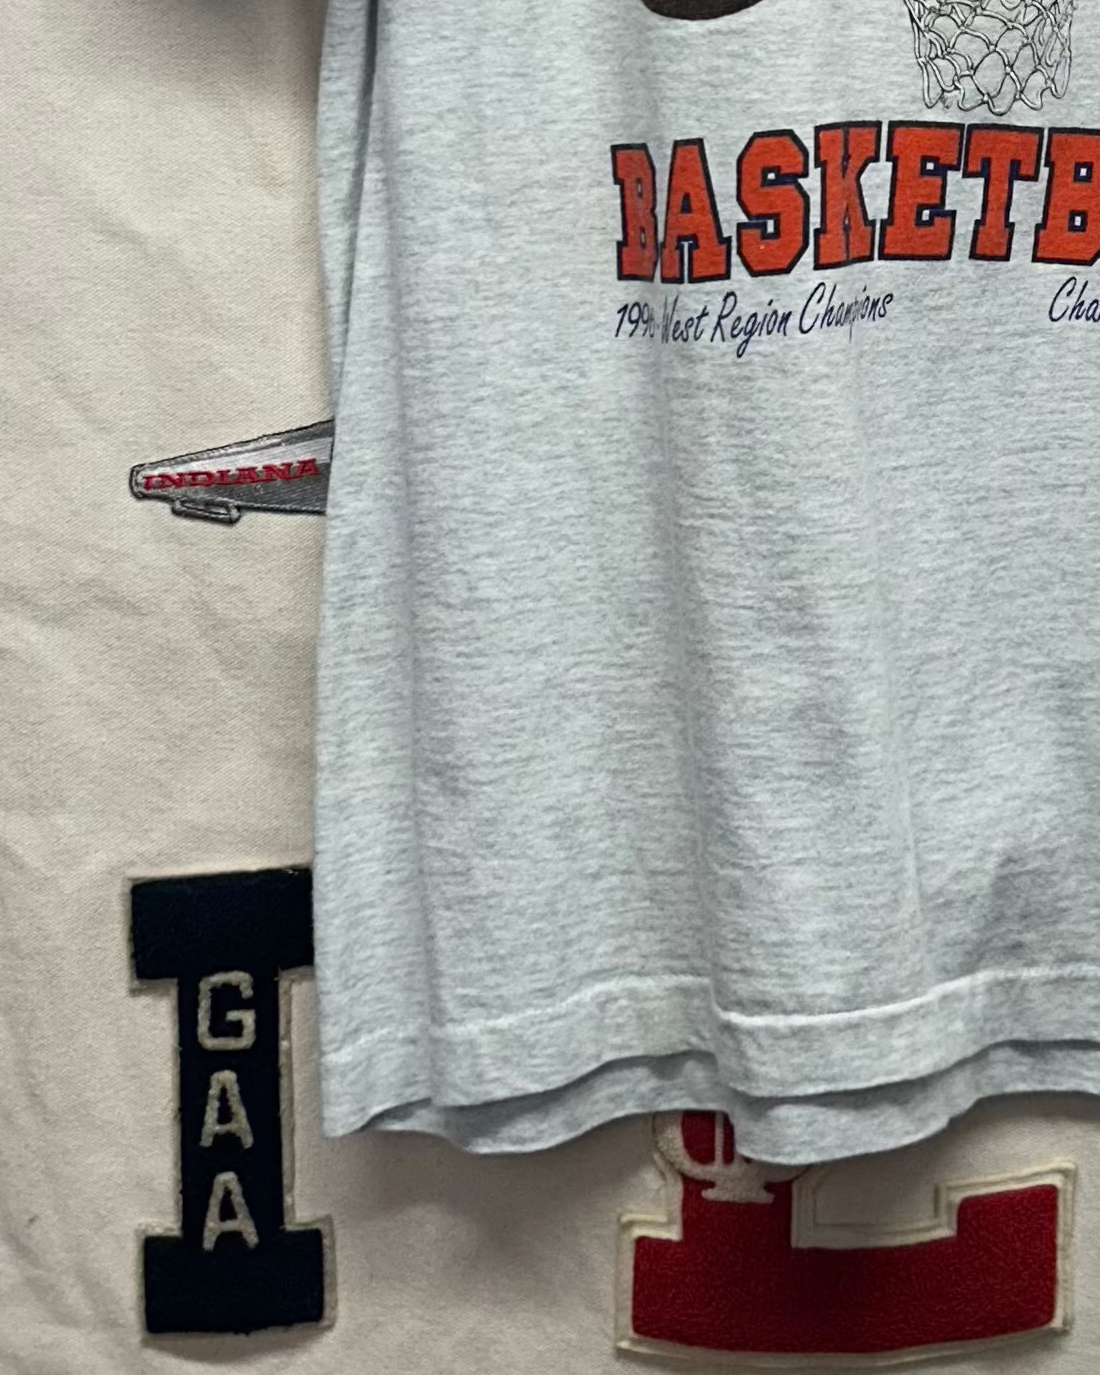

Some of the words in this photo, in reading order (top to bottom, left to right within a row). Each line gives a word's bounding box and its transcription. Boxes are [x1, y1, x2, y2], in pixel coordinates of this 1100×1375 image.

[710, 290, 793, 359] Region
[143, 457, 320, 491] INDIANA
[196, 970, 260, 1252] GAA
